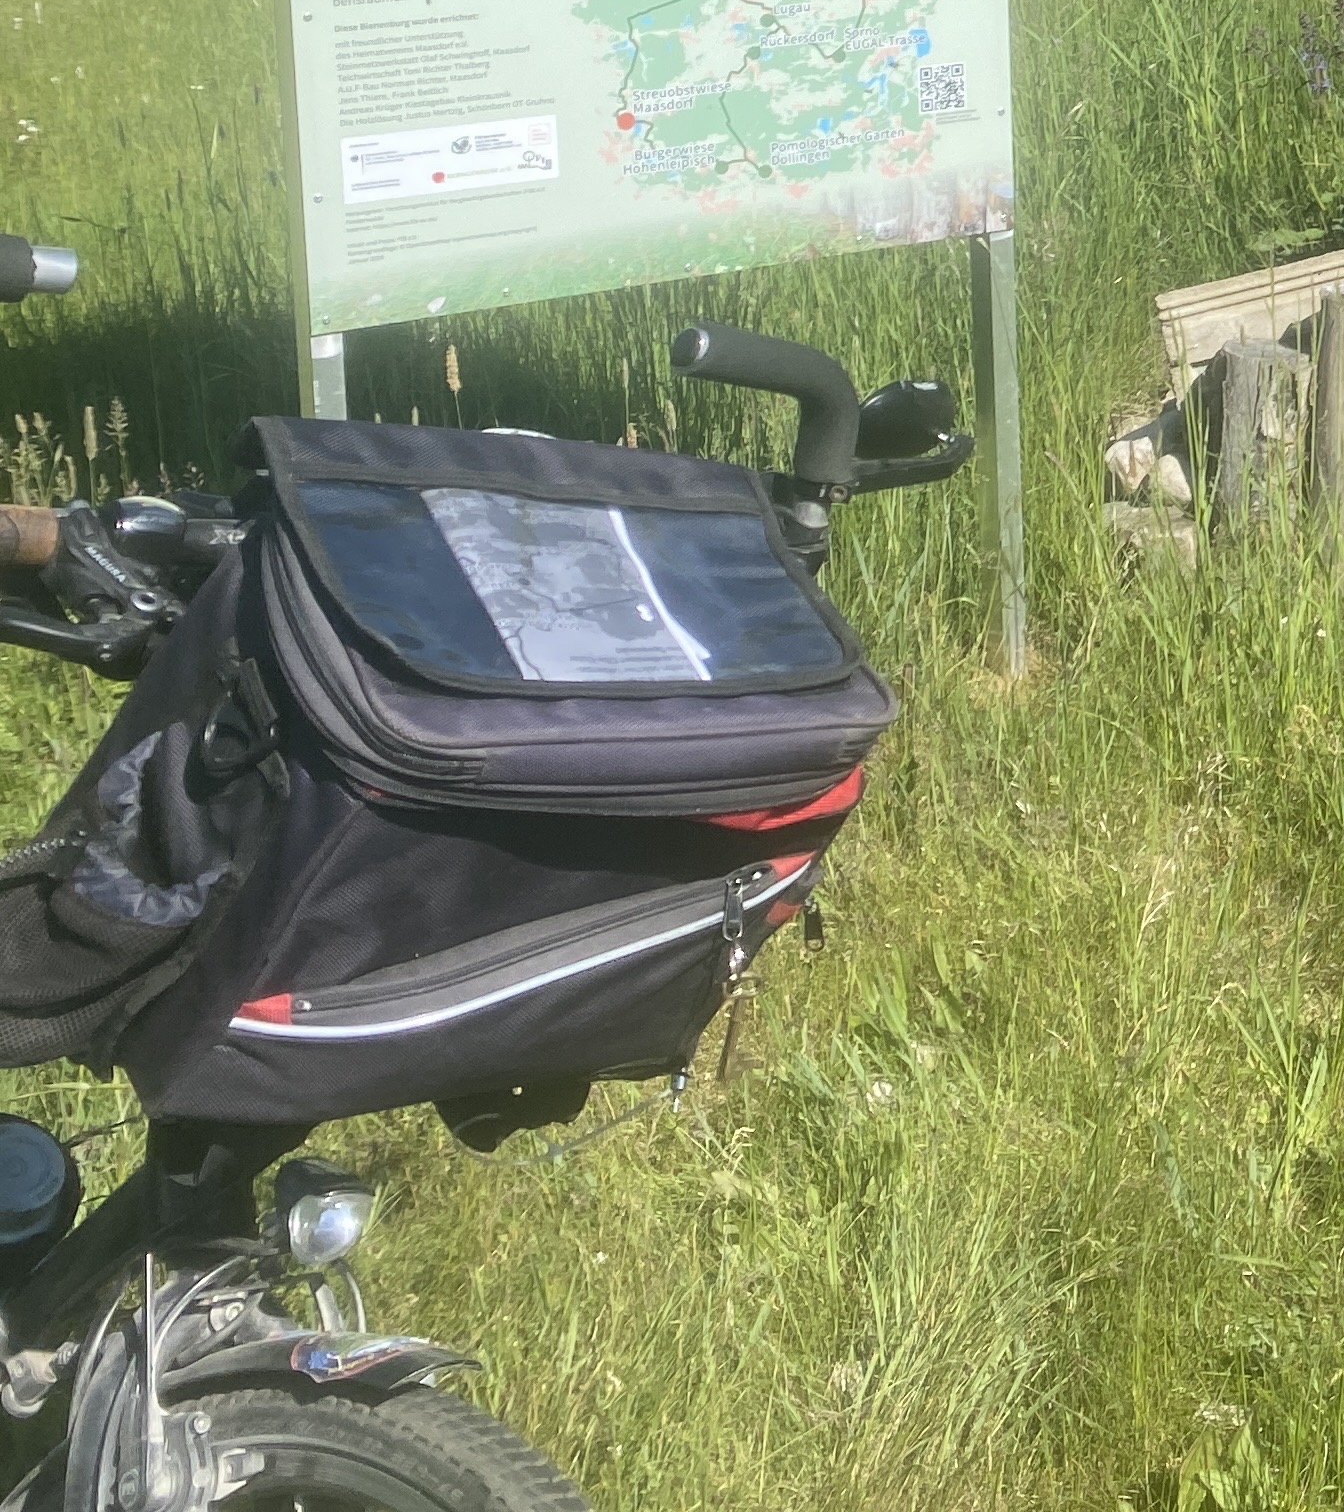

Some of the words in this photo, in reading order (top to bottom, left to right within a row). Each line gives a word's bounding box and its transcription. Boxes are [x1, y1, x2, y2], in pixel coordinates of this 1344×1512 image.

[773, 3, 811, 16] Lugau
[844, 27, 880, 38] Sorno
[632, 82, 732, 101] Streuobstwiese
[633, 97, 693, 113] Maasdorf
[771, 133, 861, 152] Pomologischer
[864, 128, 905, 142] Garten
[623, 155, 715, 174] Hohenleipisch
[84, 545, 127, 583] MAGURA
